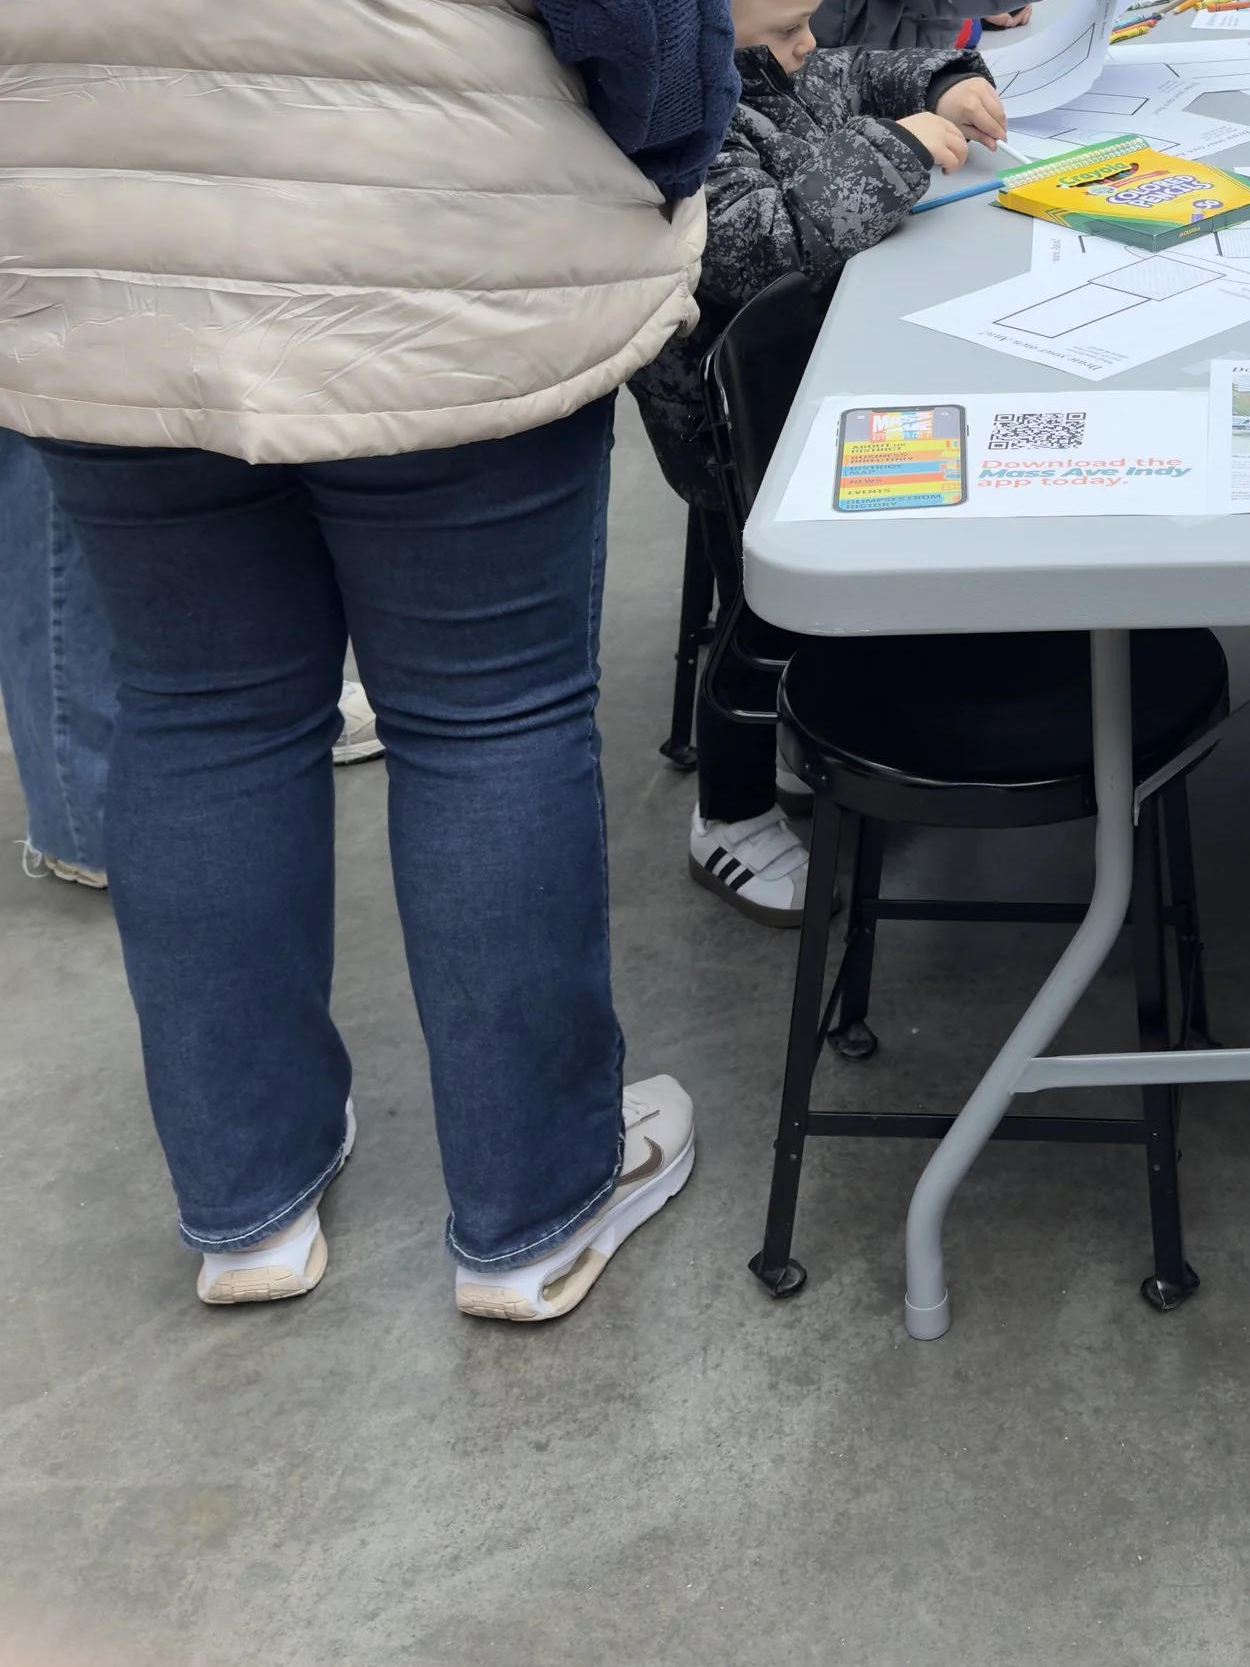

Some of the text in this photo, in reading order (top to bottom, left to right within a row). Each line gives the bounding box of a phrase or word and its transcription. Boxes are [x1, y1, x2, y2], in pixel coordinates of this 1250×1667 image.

[1057, 160, 1132, 186] Crayola
[1107, 174, 1196, 204] COLORED
[1128, 181, 1214, 208] PENCILS
[1195, 199, 1221, 210] 50
[981, 457, 1184, 469] Download the
[977, 466, 1194, 479] Mass Ave Indy
[848, 477, 882, 485] NEWS
[977, 475, 1129, 489] app today.
[848, 488, 892, 496] EVENTS
